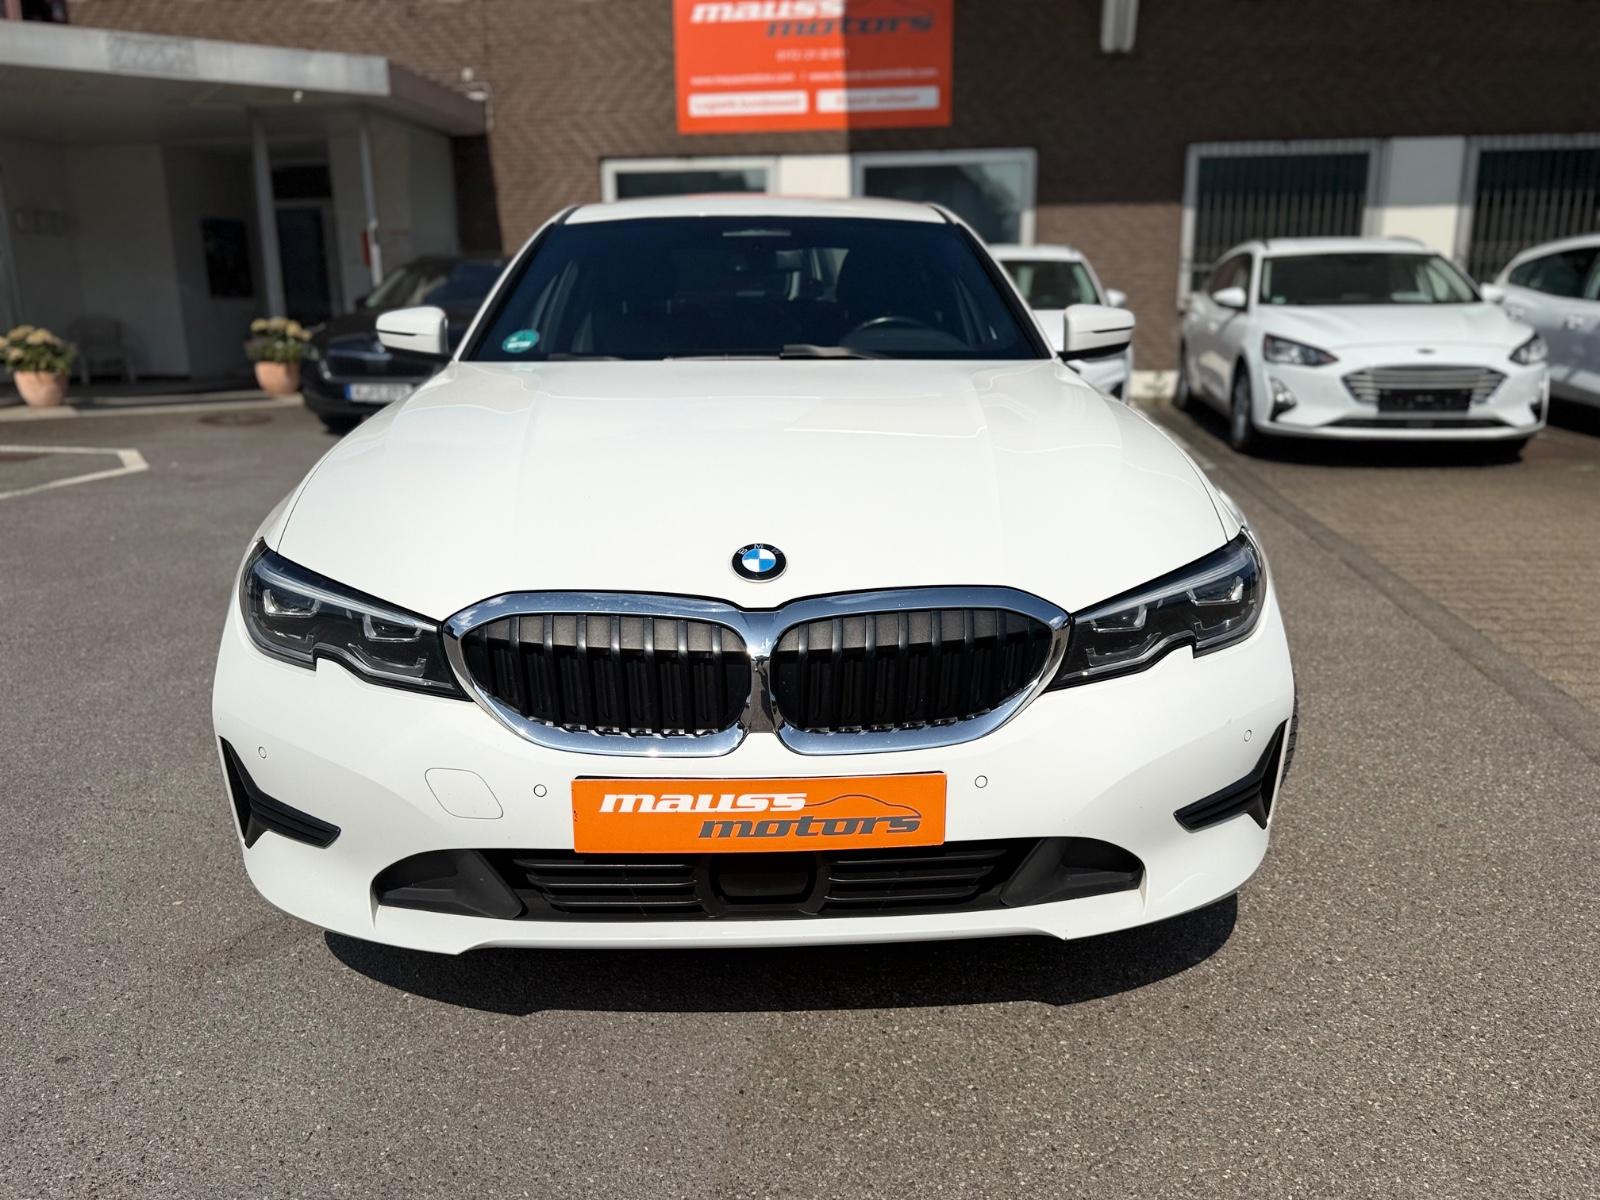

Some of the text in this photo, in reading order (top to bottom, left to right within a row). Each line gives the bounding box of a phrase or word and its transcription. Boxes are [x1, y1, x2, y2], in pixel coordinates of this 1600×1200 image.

[690, 0, 846, 24] mauss
[766, 15, 934, 38] motors
[600, 793, 807, 813] mauss
[698, 815, 922, 839] motors
